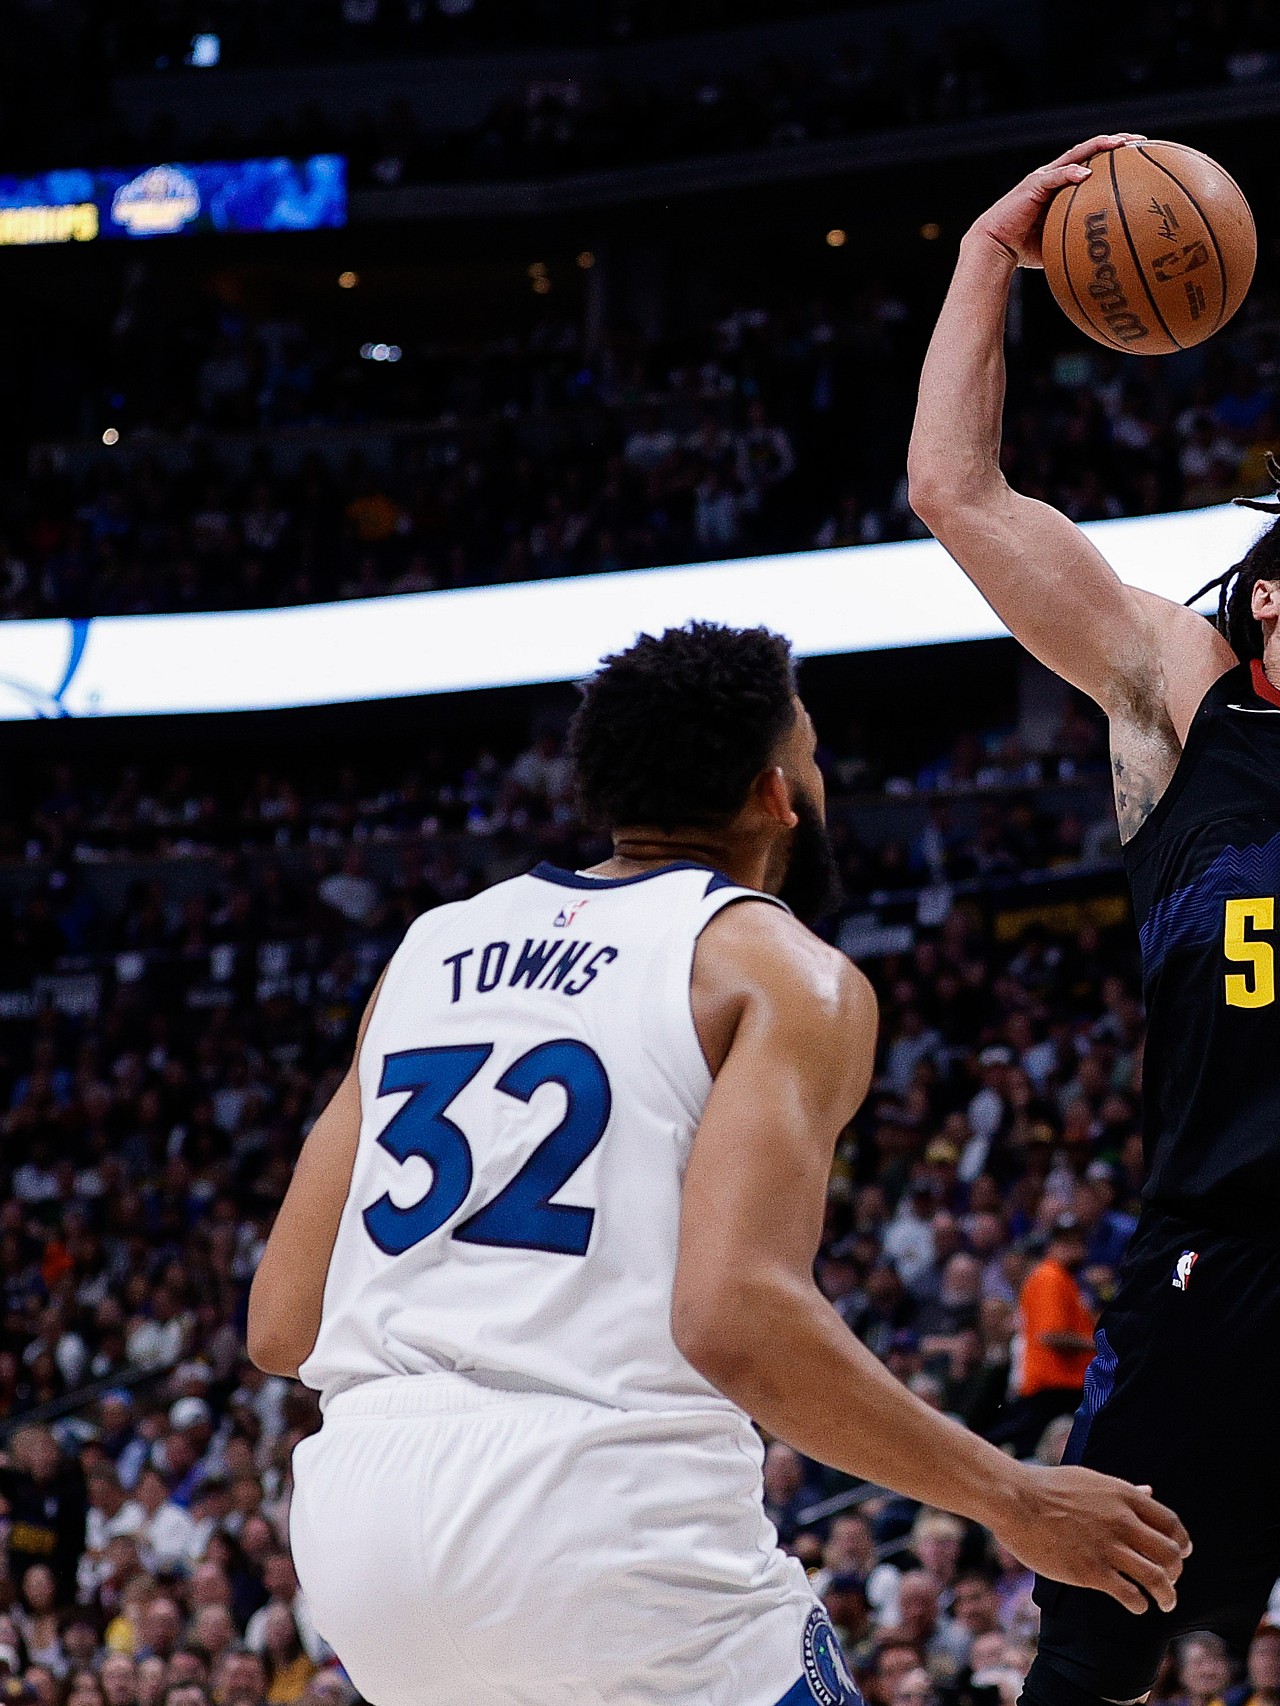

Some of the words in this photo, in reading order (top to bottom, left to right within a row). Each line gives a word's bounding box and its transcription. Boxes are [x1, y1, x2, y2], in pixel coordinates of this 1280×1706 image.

[1084, 208, 1148, 342] Wilson
[442, 938, 619, 1004] TOWNS
[362, 1038, 612, 1257] 32
